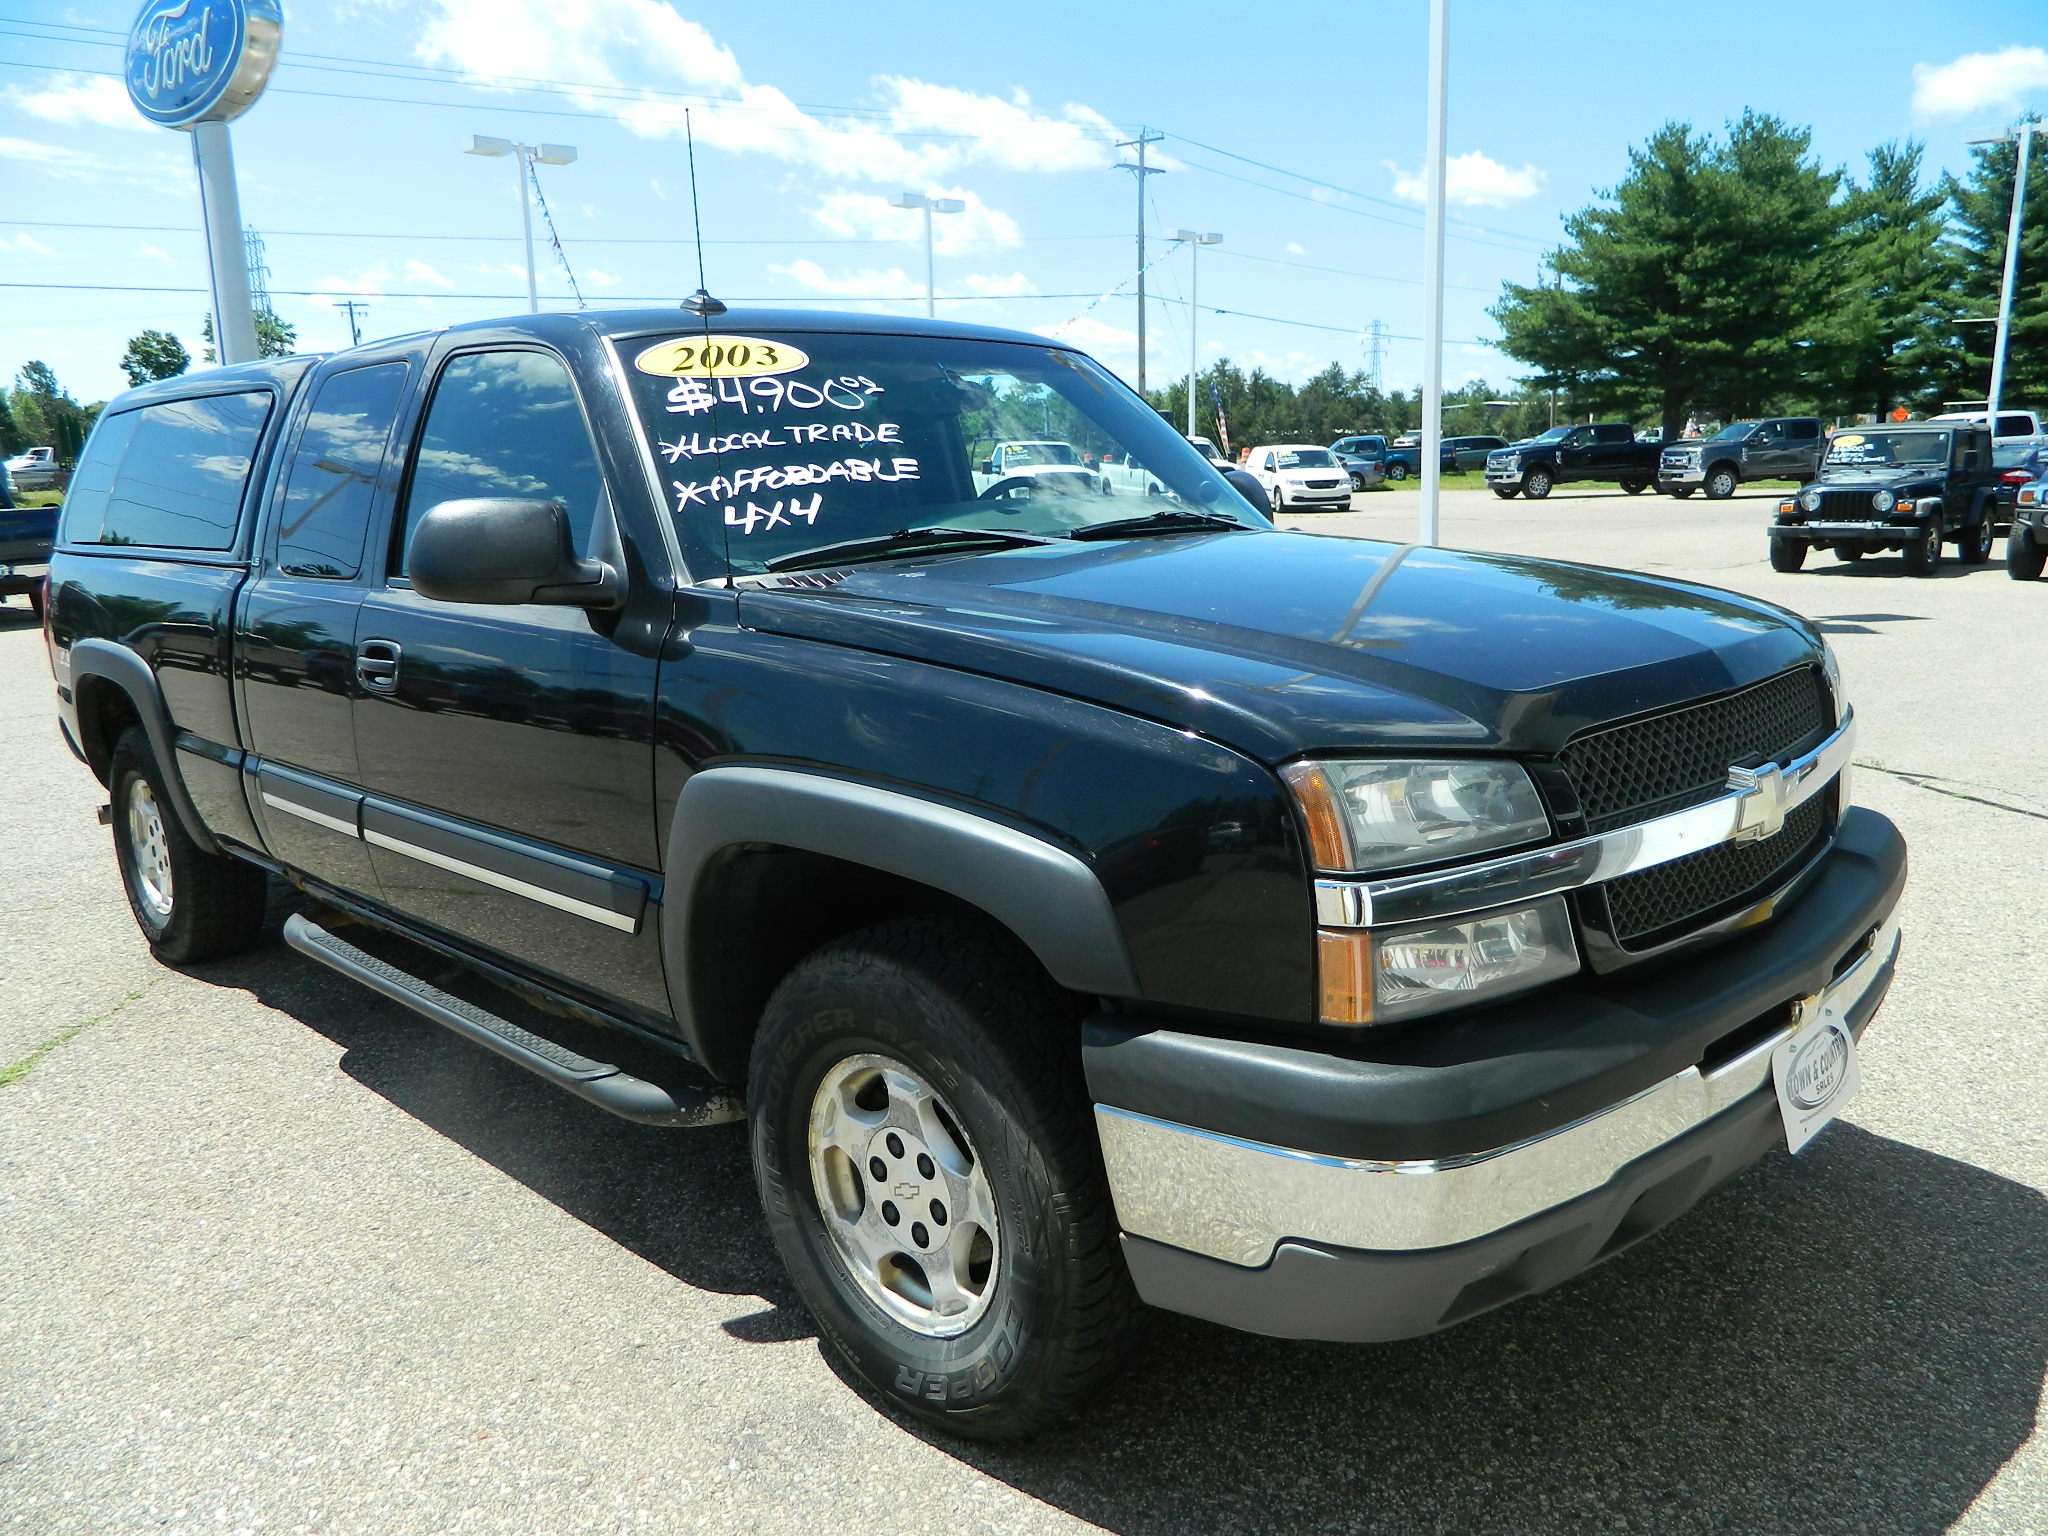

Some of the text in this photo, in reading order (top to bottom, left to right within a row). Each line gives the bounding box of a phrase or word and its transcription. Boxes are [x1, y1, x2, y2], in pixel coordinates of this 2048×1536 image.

[144, 0, 213, 99] Ford
[672, 344, 779, 372] 2003
[784, 423, 904, 444] TRADE
[1787, 1064, 1811, 1098] TOWN
[1813, 1060, 1819, 1081] &
[1815, 1072, 1834, 1095] SALES
[894, 1298, 1023, 1402] COOPER
